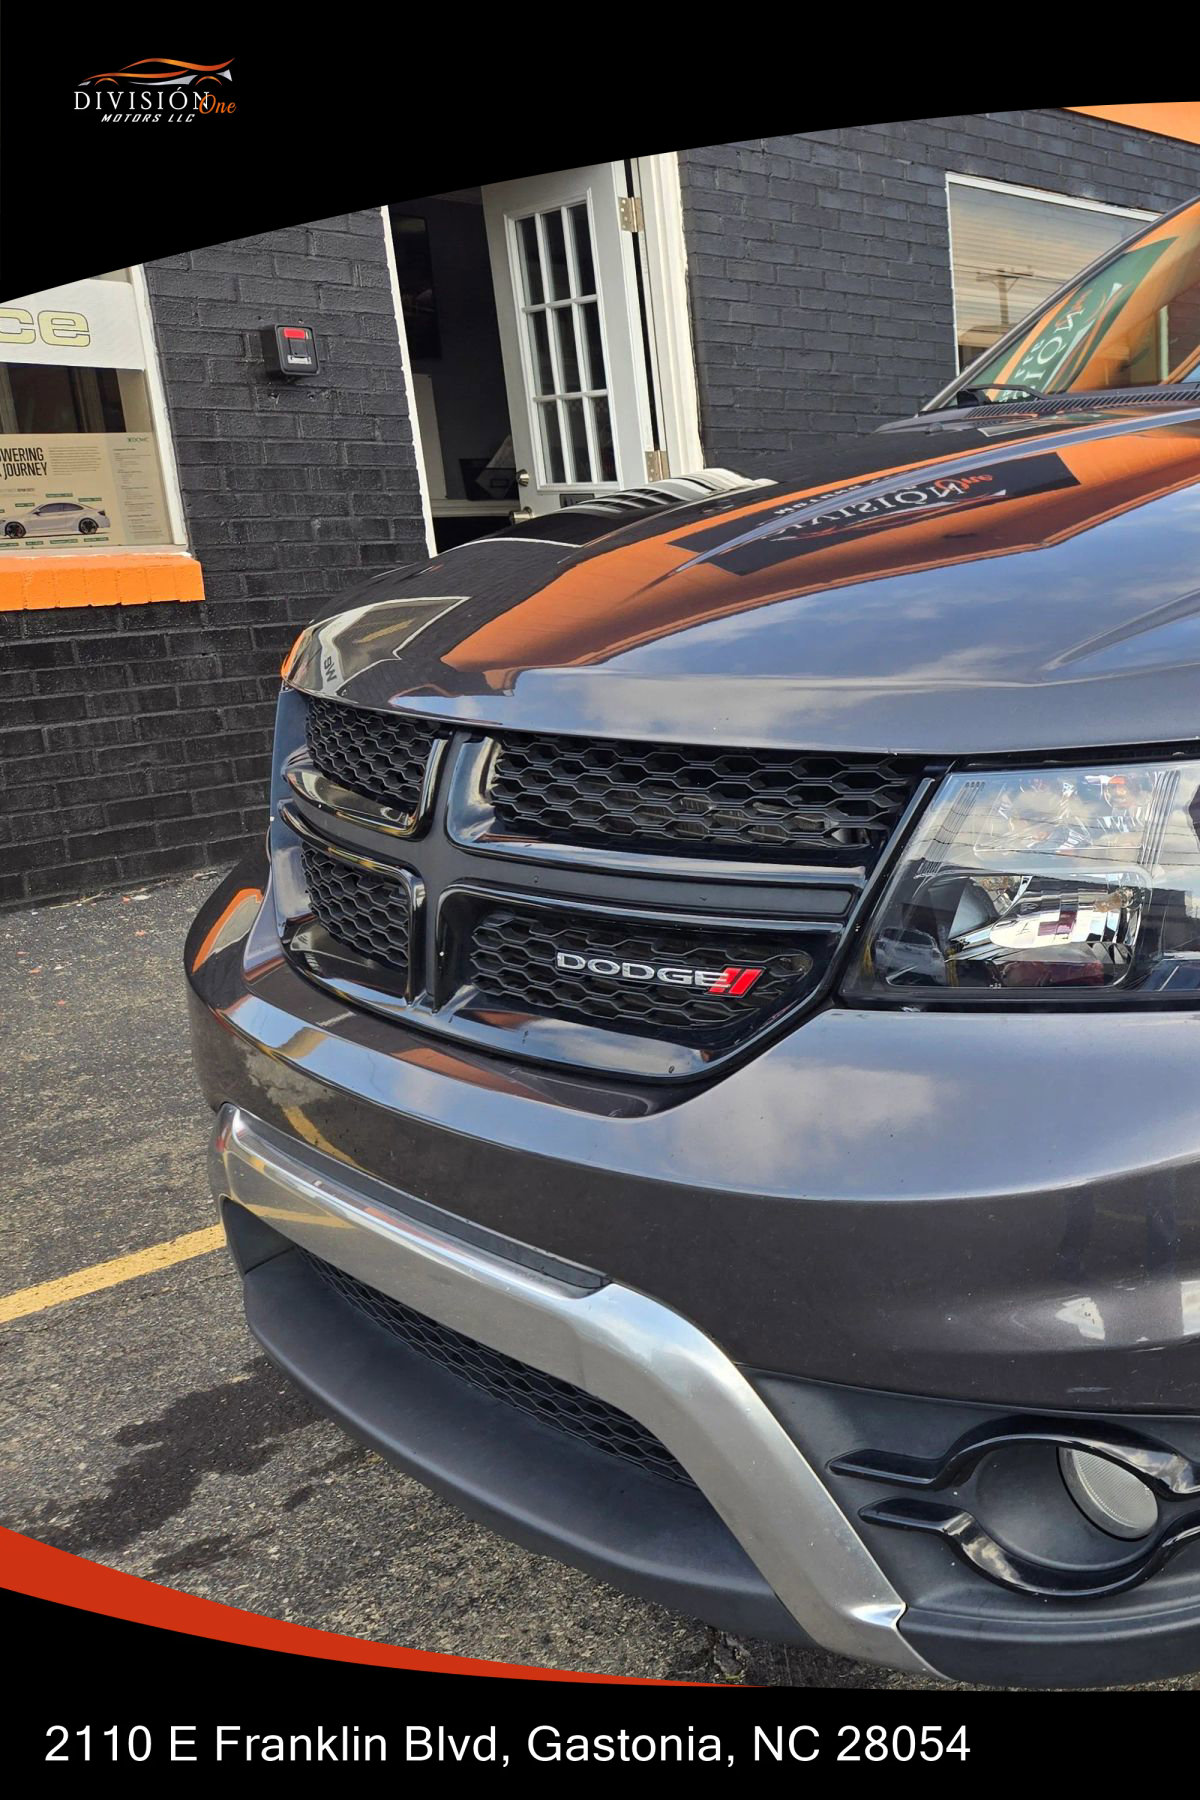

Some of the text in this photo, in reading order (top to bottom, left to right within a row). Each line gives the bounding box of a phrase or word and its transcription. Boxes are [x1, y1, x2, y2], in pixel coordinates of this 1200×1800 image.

[0, 447, 44, 462] WERING
[3, 462, 47, 480] JOURNEY
[556, 951, 731, 988] DODGE
